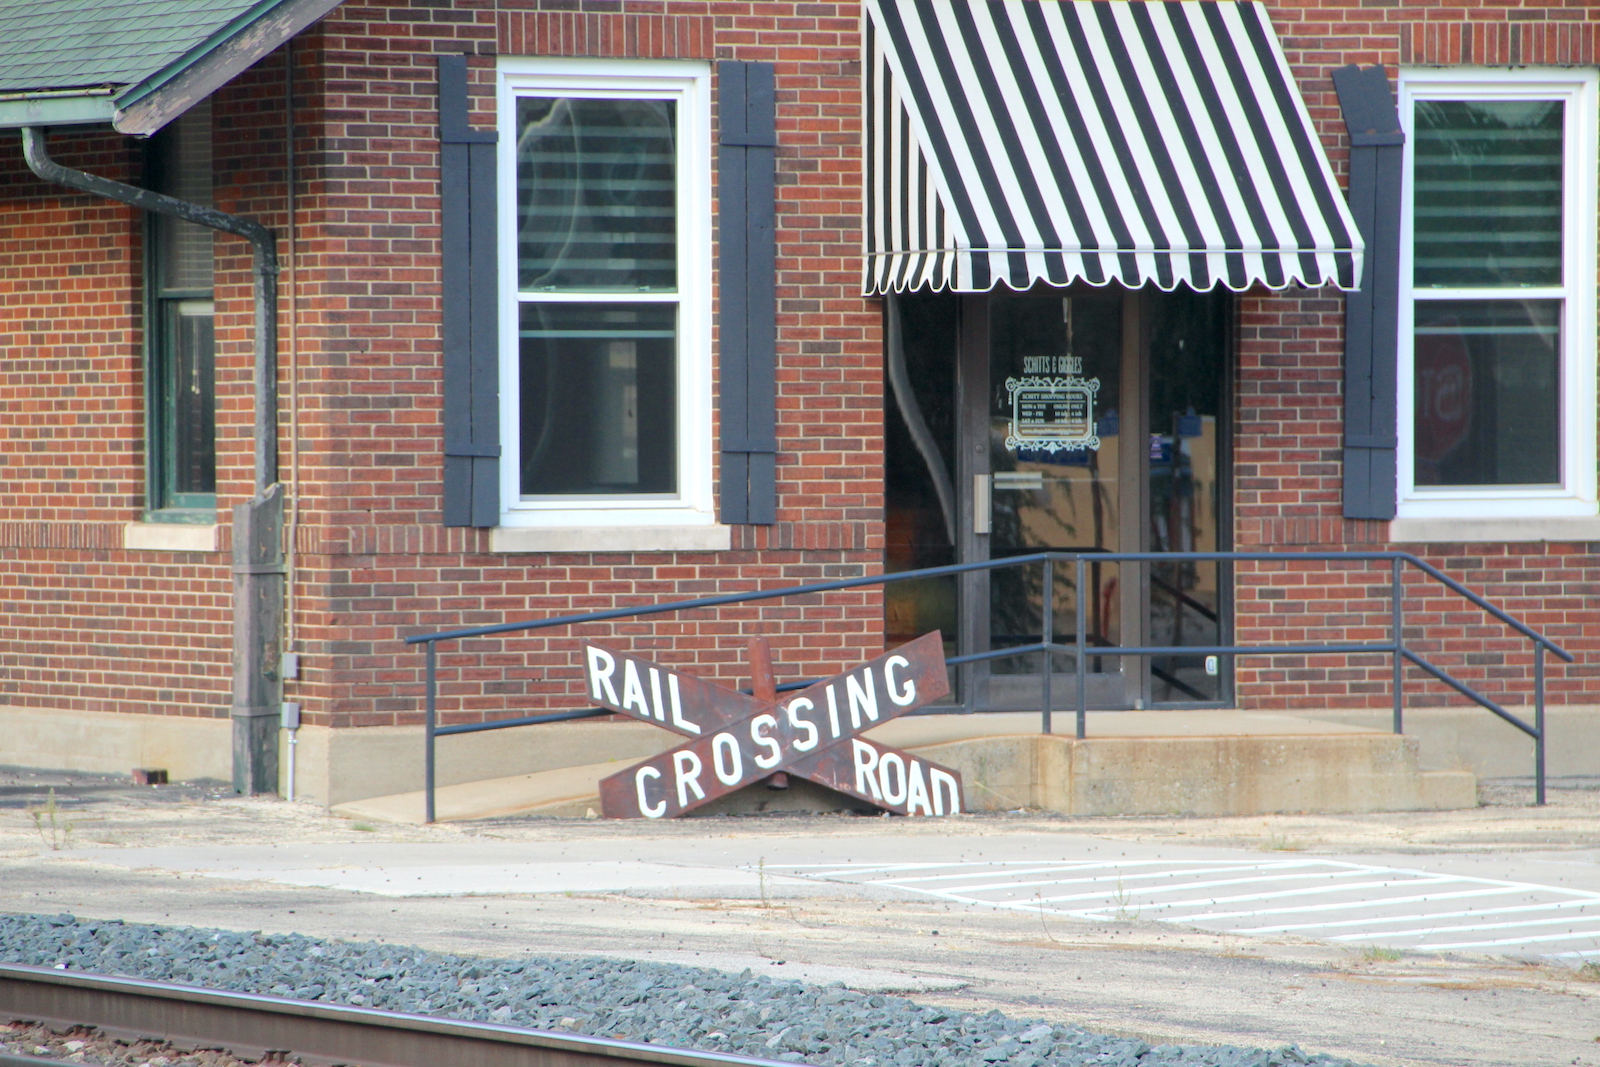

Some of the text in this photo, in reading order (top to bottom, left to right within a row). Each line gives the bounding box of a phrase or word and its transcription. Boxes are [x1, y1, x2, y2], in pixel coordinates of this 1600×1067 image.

[1023, 356, 1050, 374] SCHITTS
[586, 645, 960, 816] RAIL ROAD
[634, 654, 917, 818] CROSSING
